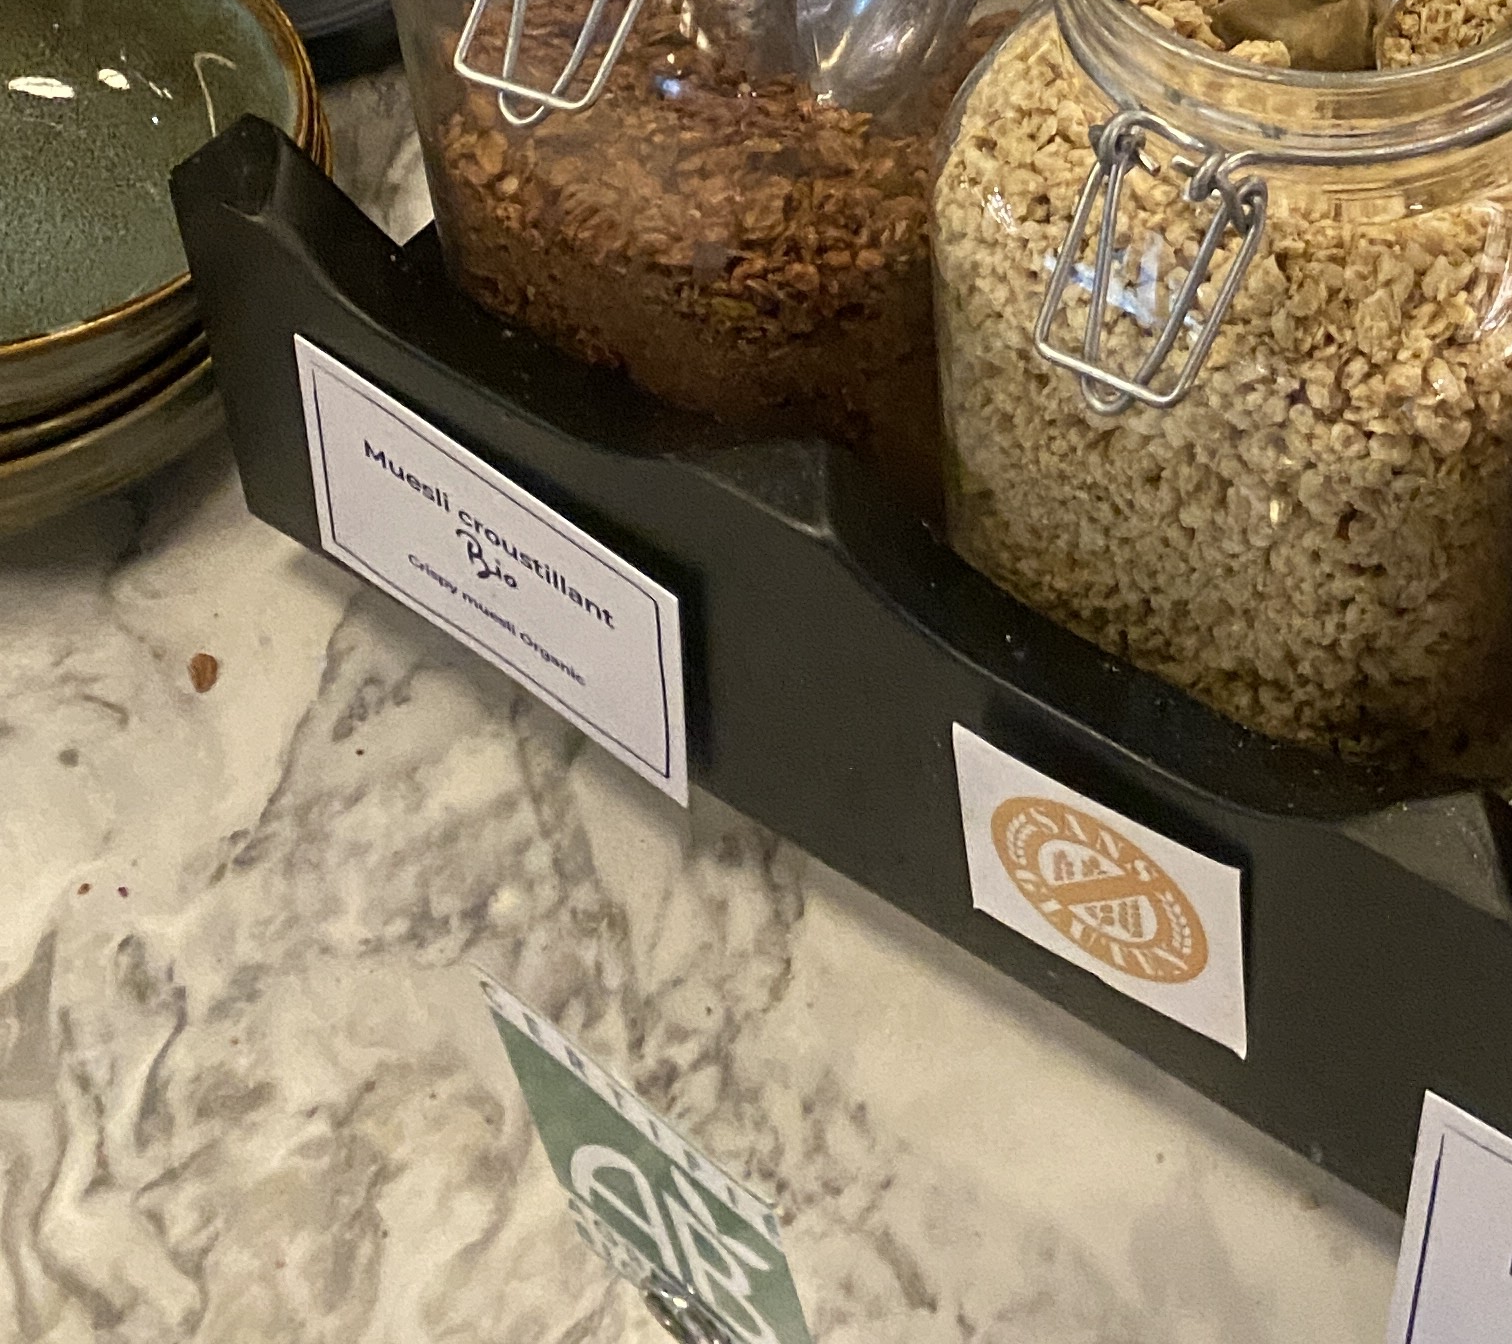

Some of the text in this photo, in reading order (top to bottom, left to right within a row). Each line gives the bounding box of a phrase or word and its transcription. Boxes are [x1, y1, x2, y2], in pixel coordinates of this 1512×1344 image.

[363, 439, 616, 630] Muesli croustillant
[455, 527, 518, 590] Bio
[407, 553, 586, 687] Crispy muesli Organic
[1029, 806, 1160, 883] SANS
